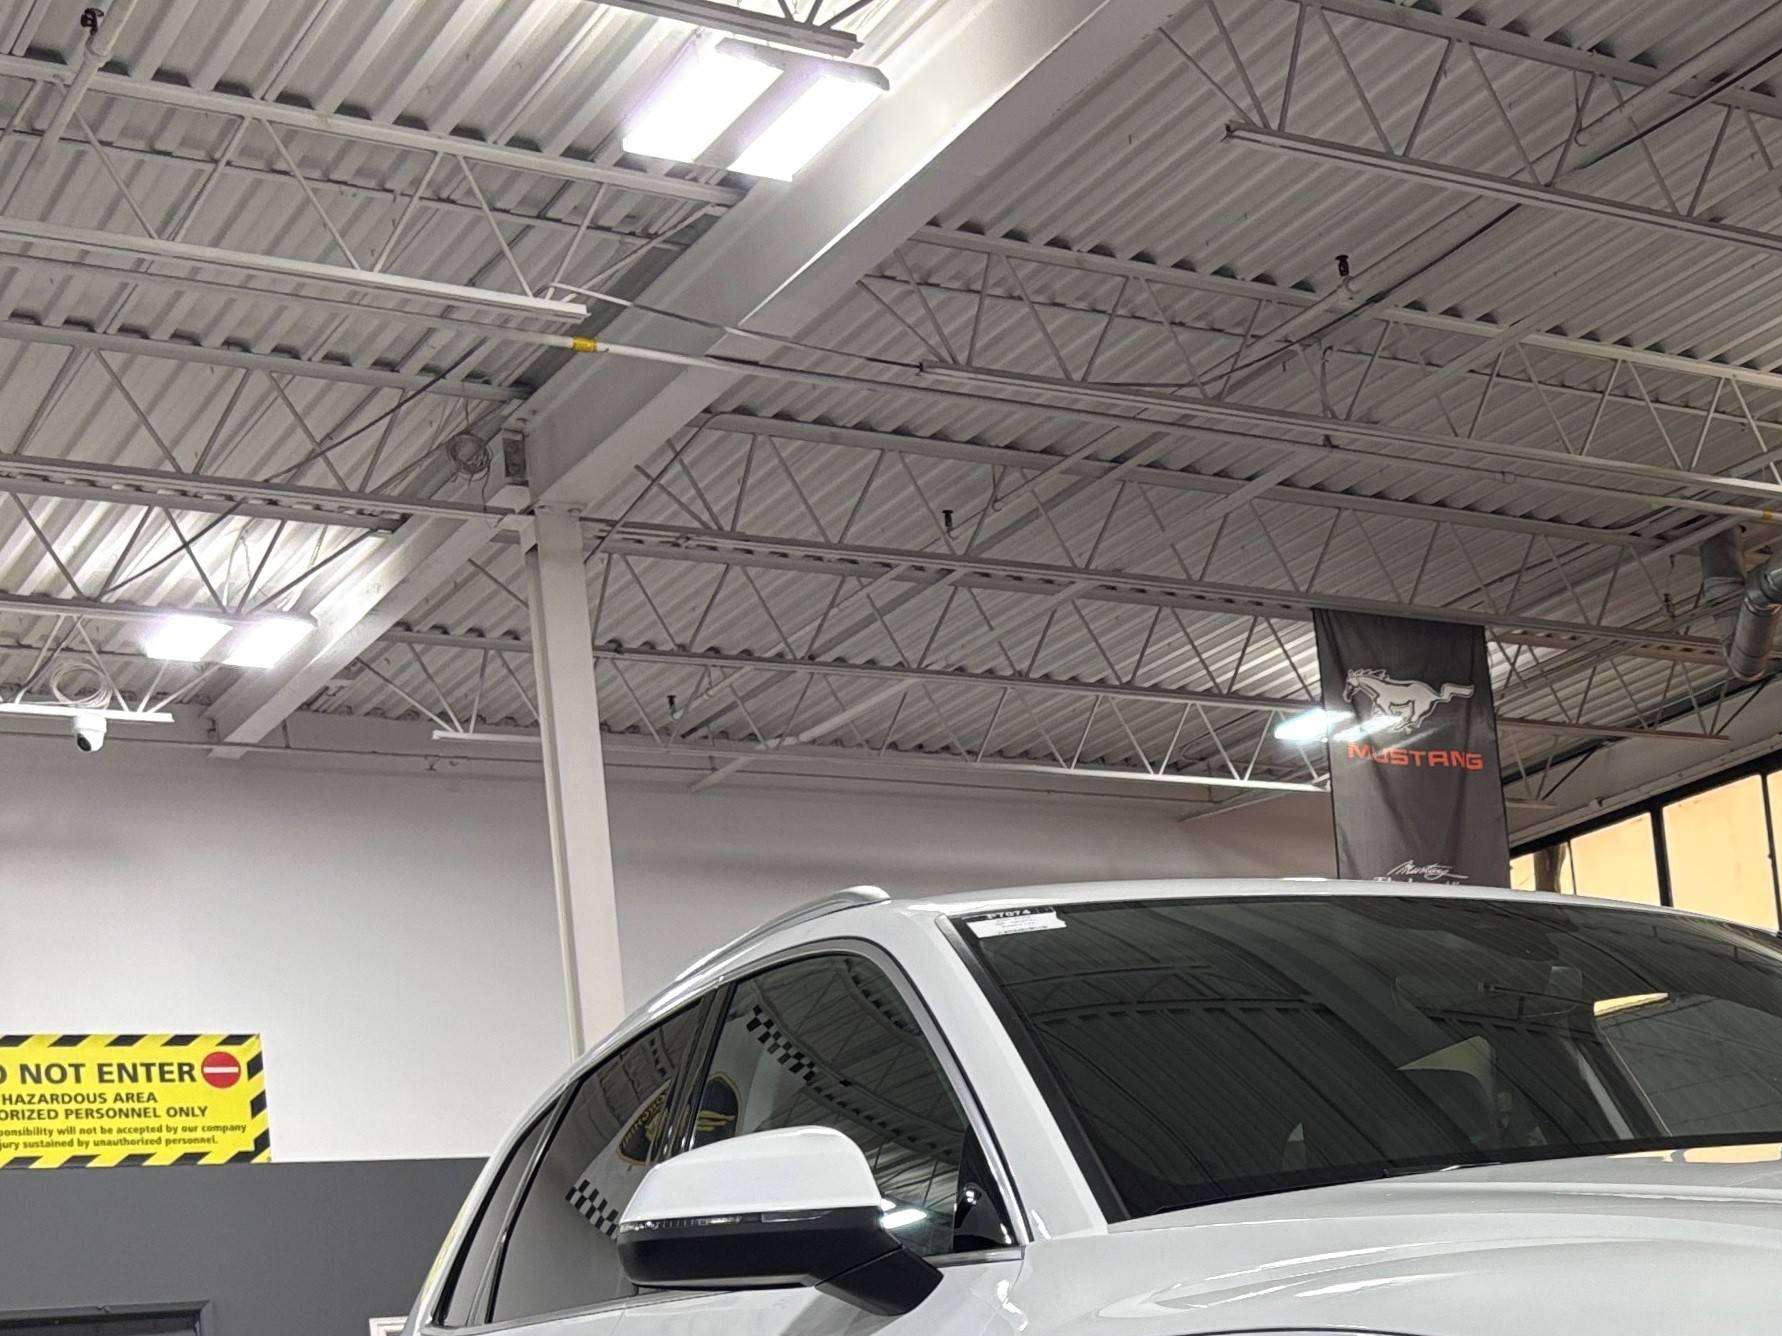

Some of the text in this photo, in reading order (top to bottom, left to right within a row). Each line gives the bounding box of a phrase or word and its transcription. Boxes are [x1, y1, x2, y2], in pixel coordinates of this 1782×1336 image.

[1347, 743, 1484, 772] MUSTANG
[19, 1062, 86, 1085] NOT
[97, 1062, 197, 1084] ENTER
[1, 1092, 158, 1106] HAZARDOUS AREA
[64, 1107, 161, 1120] PERSONNEL
[166, 1106, 208, 1118] ONLY
[57, 1126, 76, 1136] will
[80, 1126, 97, 1136] not
[100, 1125, 113, 1135] be
[117, 1125, 163, 1137] accepted
[166, 1124, 179, 1135] by
[181, 1125, 199, 1134] our
[201, 1123, 247, 1134] company
[23, 1138, 74, 1149] sustained
[77, 1137, 90, 1149] by
